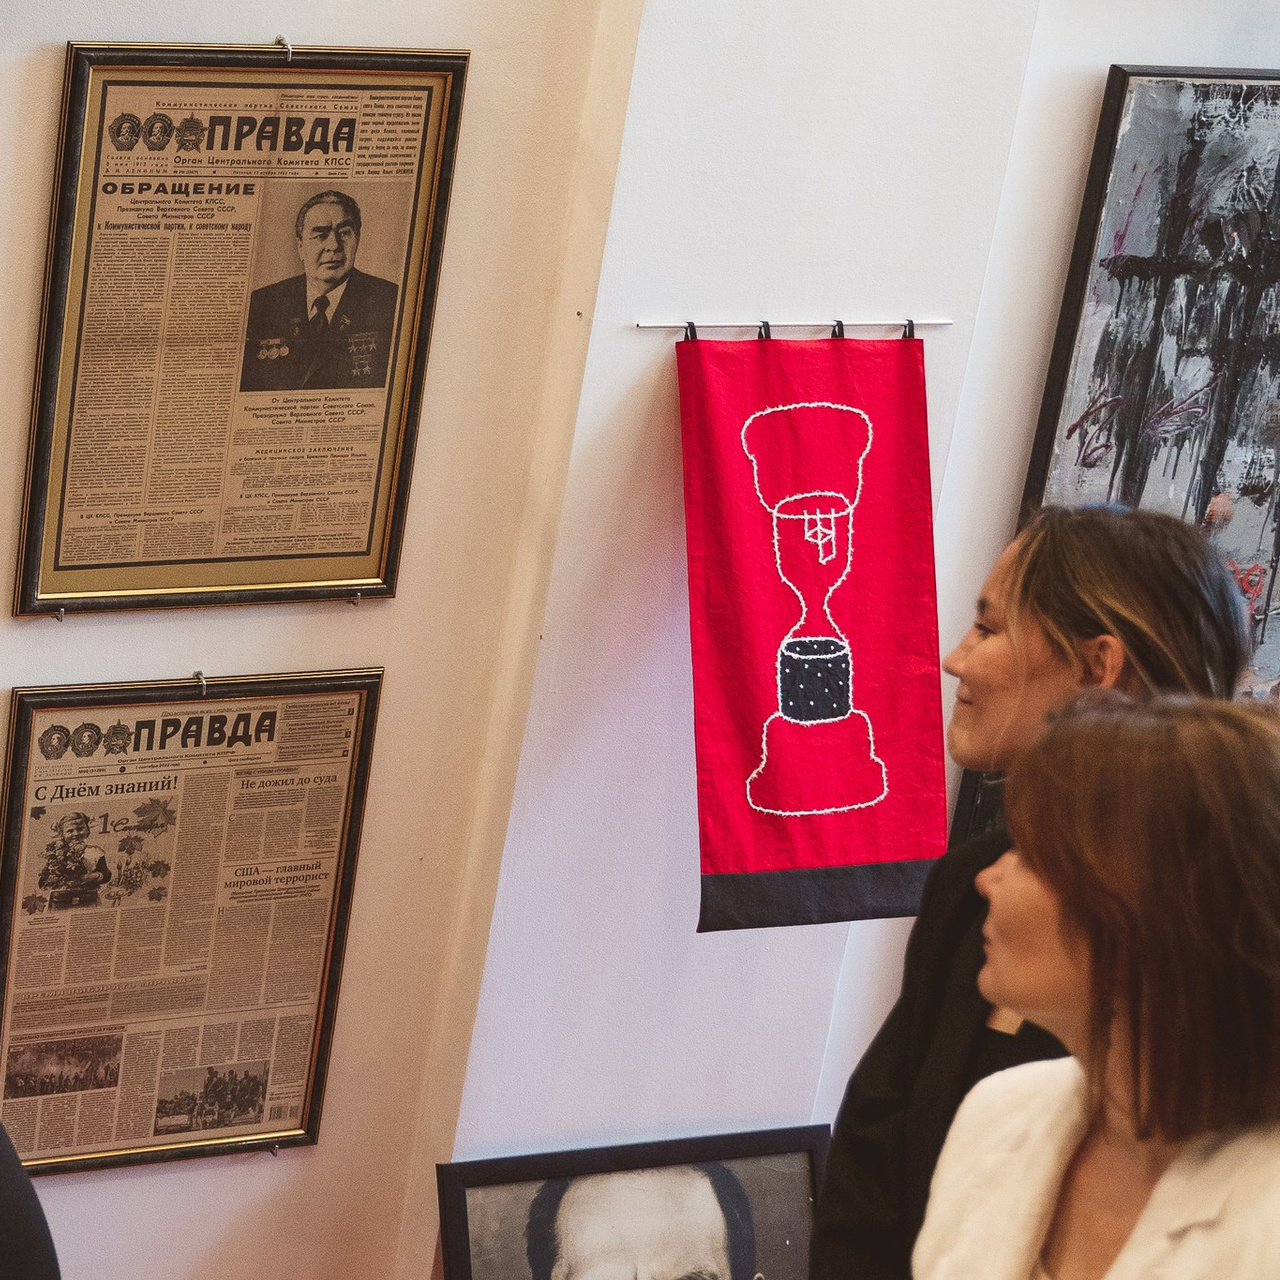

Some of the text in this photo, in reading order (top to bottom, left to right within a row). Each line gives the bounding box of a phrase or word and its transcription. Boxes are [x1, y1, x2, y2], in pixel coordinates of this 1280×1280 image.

[205, 116, 357, 155] ПРАВДА
[174, 156, 351, 167] Орган Центрального Комитета КПСС
[102, 182, 255, 198] ОБРАЩЕНИЕ
[133, 710, 277, 752] ПРАВДА
[35, 776, 178, 802] С Днём знаний!
[241, 775, 337, 789] Не дожил до суда
[234, 867, 260, 877] США
[275, 861, 321, 873] главный
[224, 872, 329, 889] мировой террорист
